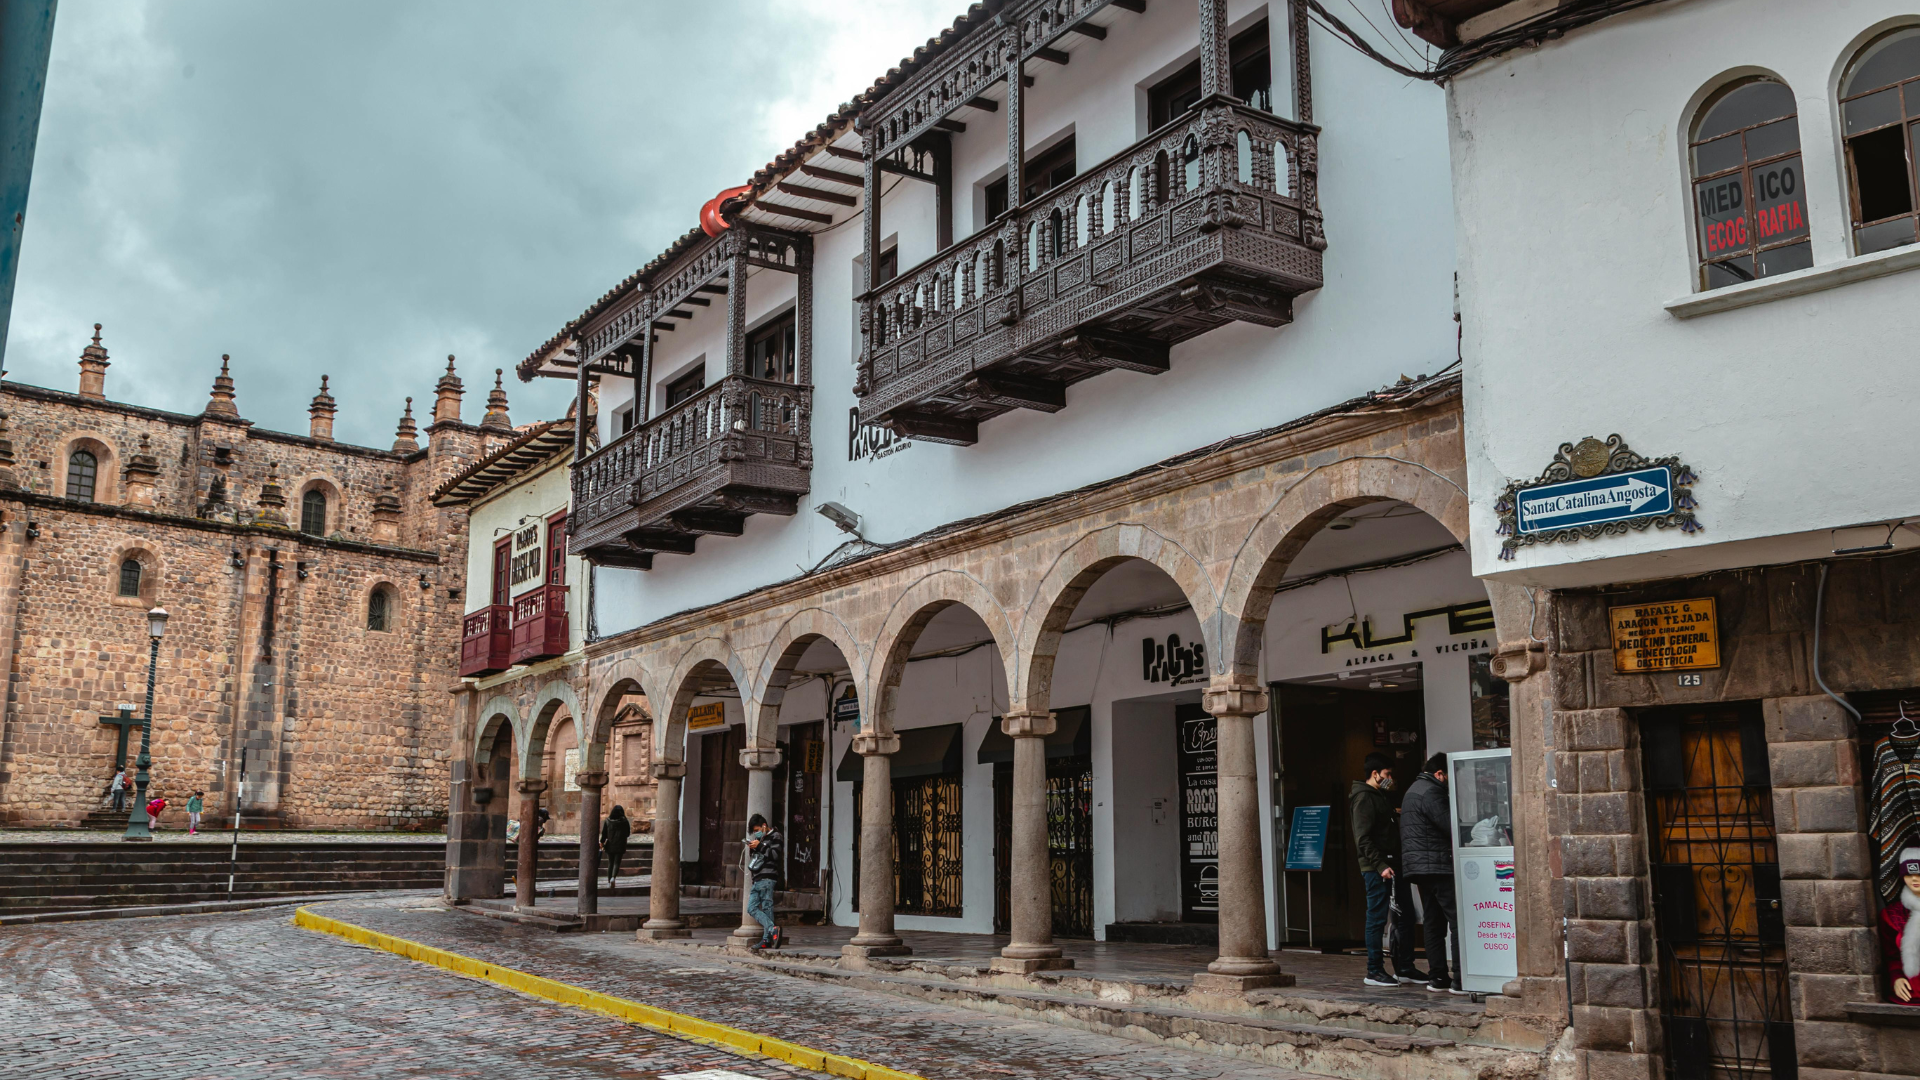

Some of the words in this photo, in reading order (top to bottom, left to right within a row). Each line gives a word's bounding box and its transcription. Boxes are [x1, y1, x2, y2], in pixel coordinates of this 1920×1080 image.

[1634, 605, 1679, 618] RAFAEL
[1682, 604, 1693, 613] G.
[1617, 617, 1658, 630] ARAGON
[1664, 612, 1710, 625] TEJADA
[1628, 628, 1657, 637] MEDICO
[1659, 625, 1696, 635] CIRUJANO
[1619, 637, 1666, 650] MEDICINA
[1669, 632, 1710, 646] GENERAL
[1345, 653, 1395, 667] ALPACA
[1411, 650, 1419, 658] &
[1435, 639, 1489, 654] VICUÑA
[1636, 645, 1697, 658] GINECOLOGIA
[1636, 656, 1694, 668] OBSTETRICIA
[1677, 675, 1701, 686] 125
[1473, 900, 1513, 912] TAMALES
[1477, 921, 1511, 929] JOSEFINA
[1477, 931, 1498, 939] Desde
[1499, 931, 1515, 940] 1924
[1483, 942, 1509, 951] CUSCO
